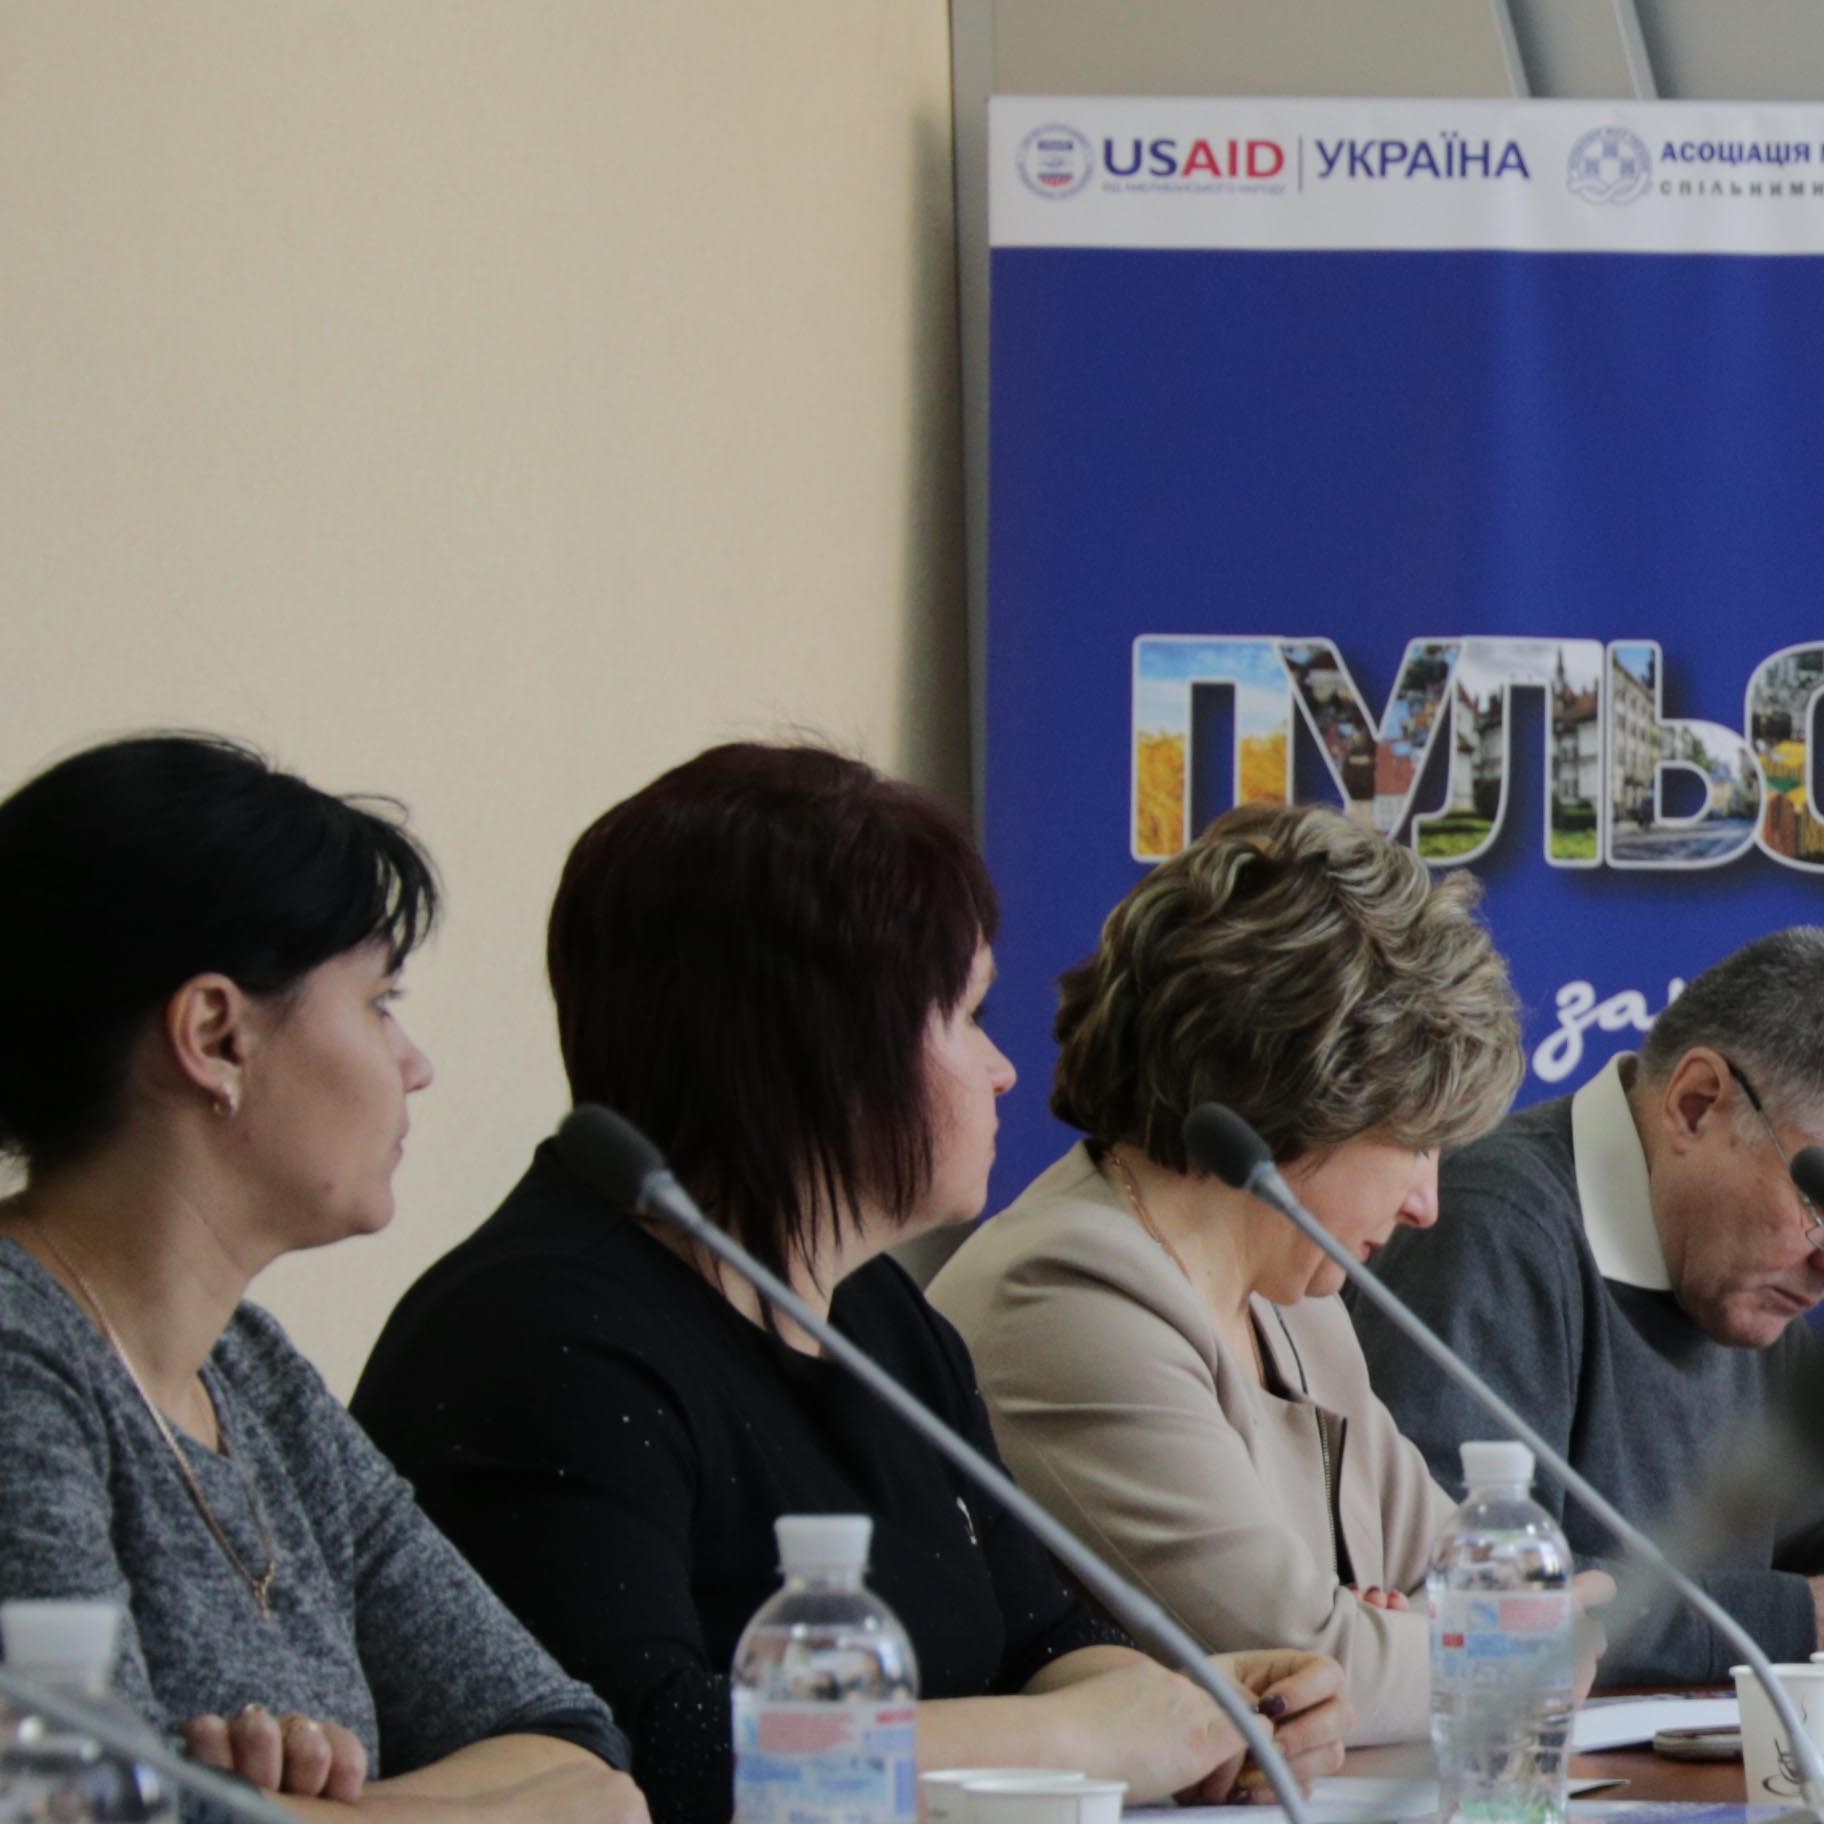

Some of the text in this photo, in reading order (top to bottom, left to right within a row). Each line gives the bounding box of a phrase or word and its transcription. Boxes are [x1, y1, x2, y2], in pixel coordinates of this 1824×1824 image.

[1102, 138, 1286, 178] USAID
[1315, 131, 1532, 180] УКРАЇНА
[1660, 140, 1811, 168] АСОЦІАЦІЯ
